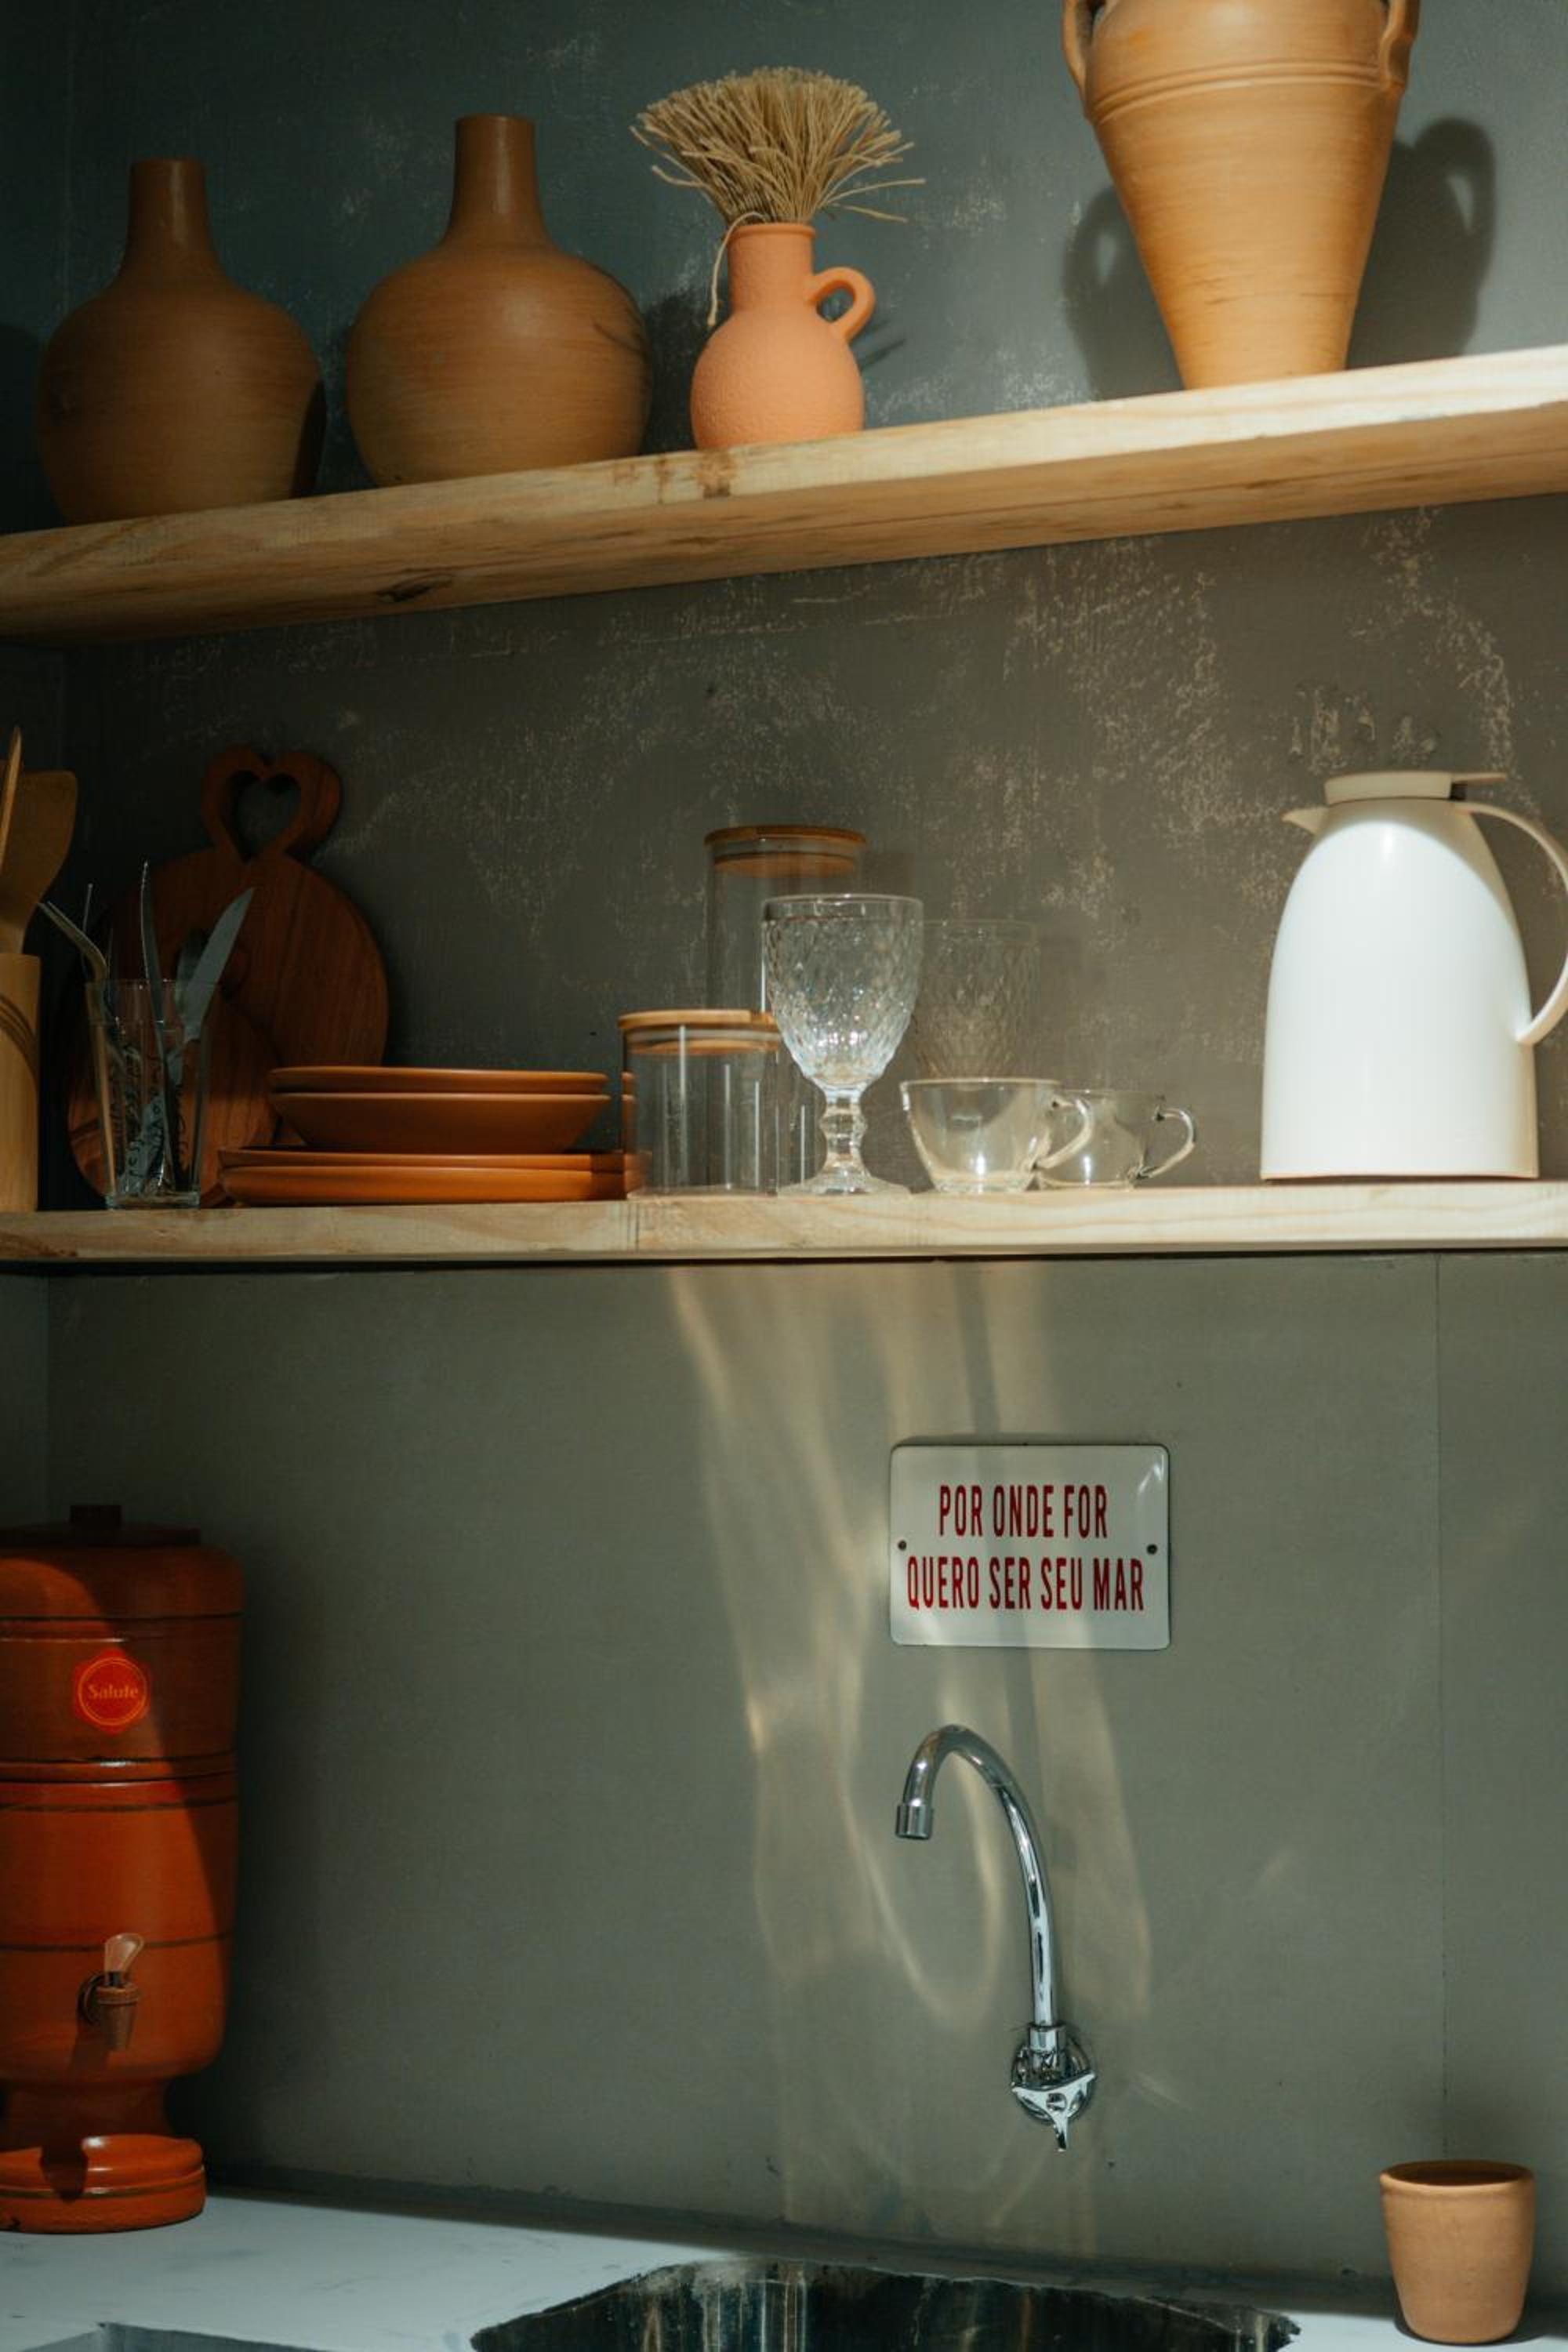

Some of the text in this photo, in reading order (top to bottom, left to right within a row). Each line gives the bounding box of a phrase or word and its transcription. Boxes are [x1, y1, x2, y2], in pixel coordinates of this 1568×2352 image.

[940, 1484, 1108, 1539] POR ONDE FOR
[907, 1555, 1145, 1611] QUERO SER SEU MAR
